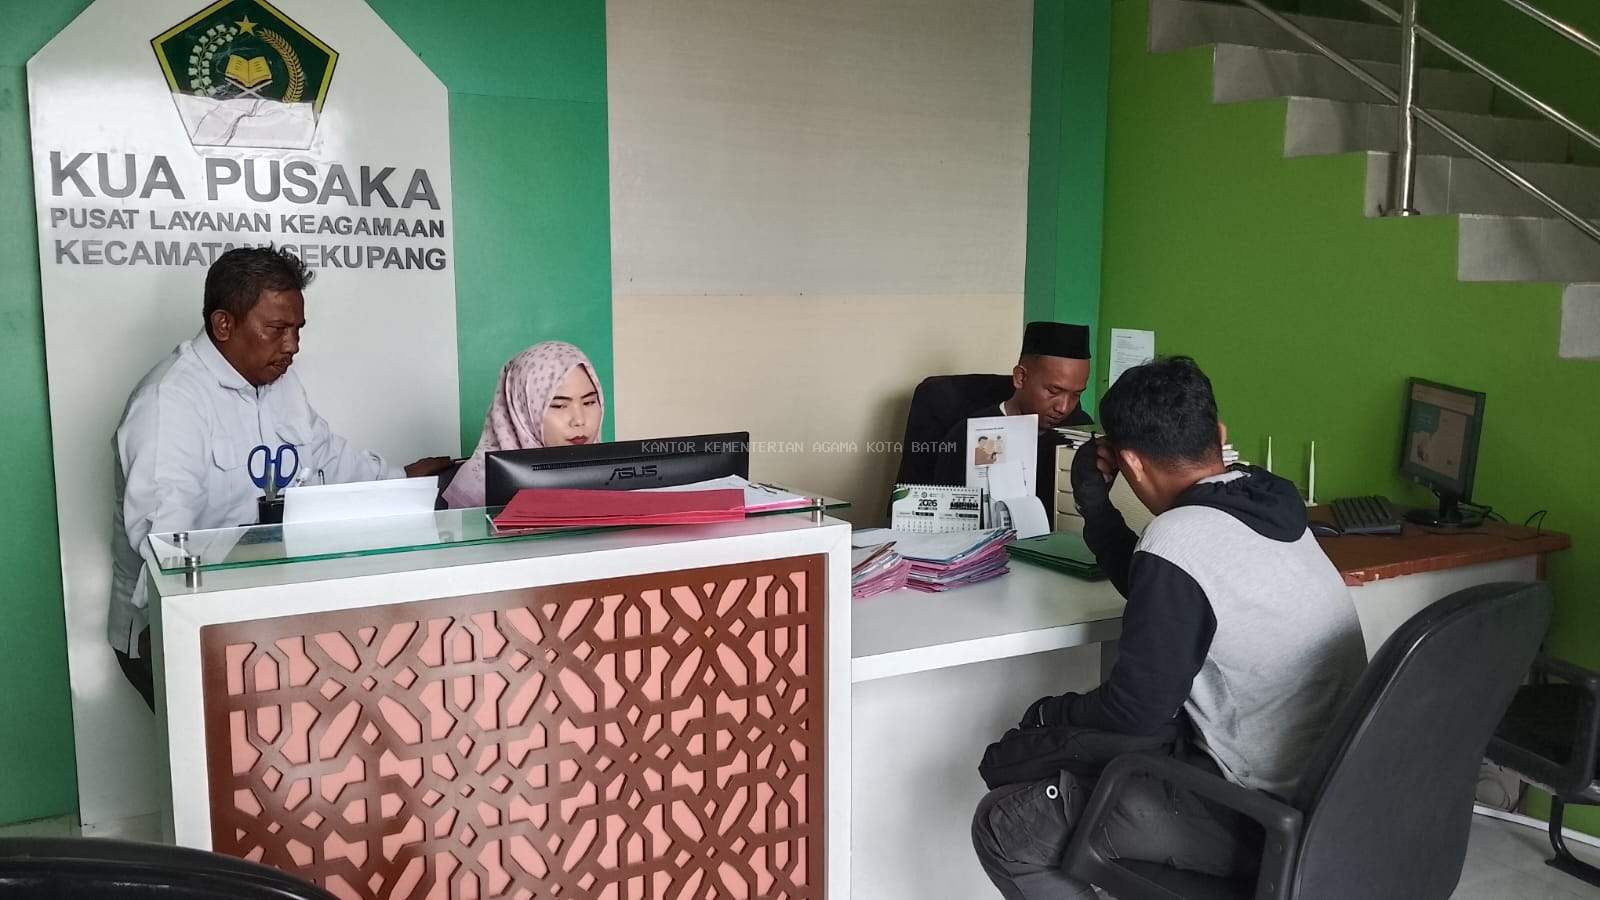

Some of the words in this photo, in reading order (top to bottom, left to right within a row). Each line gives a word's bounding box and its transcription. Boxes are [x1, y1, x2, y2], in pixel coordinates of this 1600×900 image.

[49, 151, 185, 200] KUA
[205, 157, 441, 210] PUSAKA
[50, 207, 140, 232] PUSAT
[149, 210, 272, 233] LAYANAN
[280, 214, 445, 238] KEAGAMAAN
[55, 239, 268, 267] KECAMAT
[609, 465, 658, 481] ASUS
